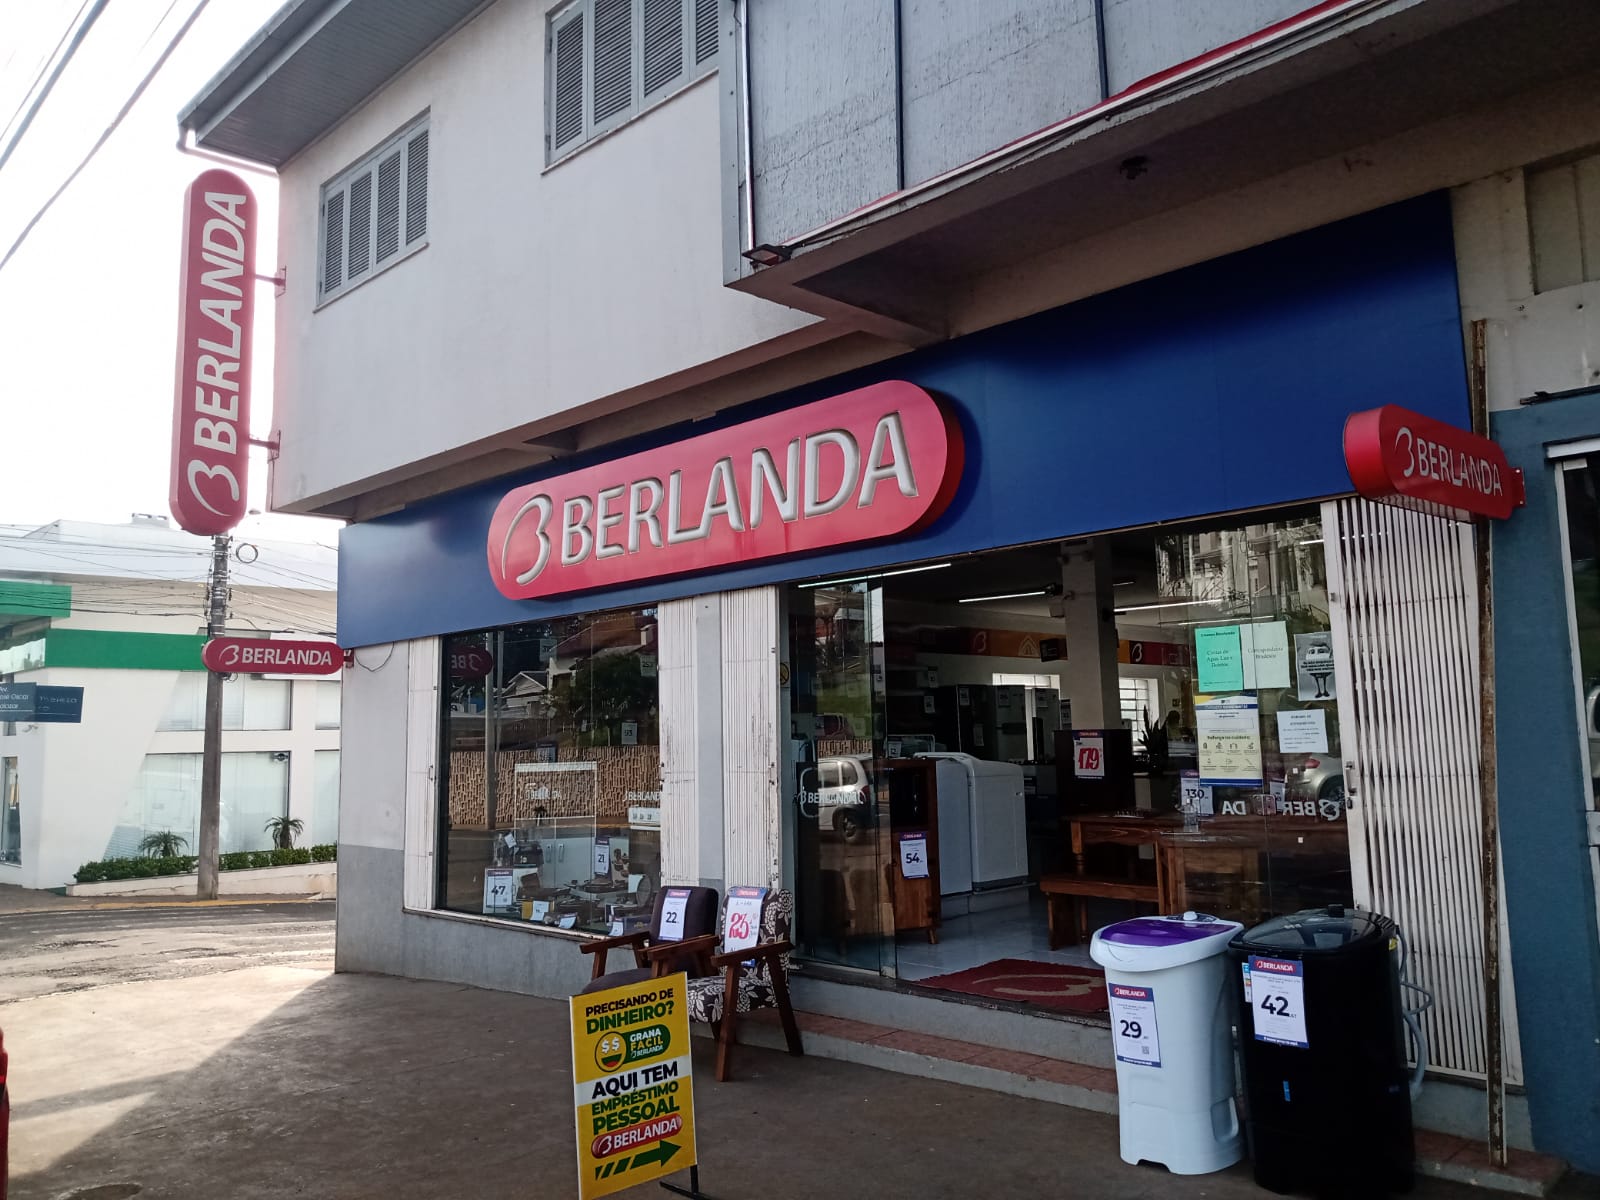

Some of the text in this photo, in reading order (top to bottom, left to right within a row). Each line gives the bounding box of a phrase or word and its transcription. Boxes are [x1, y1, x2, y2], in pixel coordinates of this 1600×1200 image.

[193, 191, 247, 455] BERLANDA
[1416, 438, 1503, 497] BERLANDA
[561, 410, 919, 567] BERLANDA
[241, 647, 332, 666] BERLANDA
[1185, 788, 1205, 800] 130
[905, 852, 920, 864] 54
[491, 885, 506, 896] 47
[665, 911, 678, 924] 22
[1263, 961, 1294, 972] BERLANDA
[585, 988, 674, 1017] PRECISANDO DE
[1260, 994, 1290, 1017] 42
[586, 1000, 675, 1035] DINHEIRO?
[1120, 1019, 1142, 1039] 29
[629, 1028, 662, 1042] GRANA
[637, 1045, 664, 1056] BERLANDA
[592, 1061, 678, 1099] AQUI TEM
[592, 1081, 679, 1116] EMPRÉSTIMO
[593, 1096, 680, 1135] PESSOAL
[614, 1118, 678, 1149] BERLANDA
